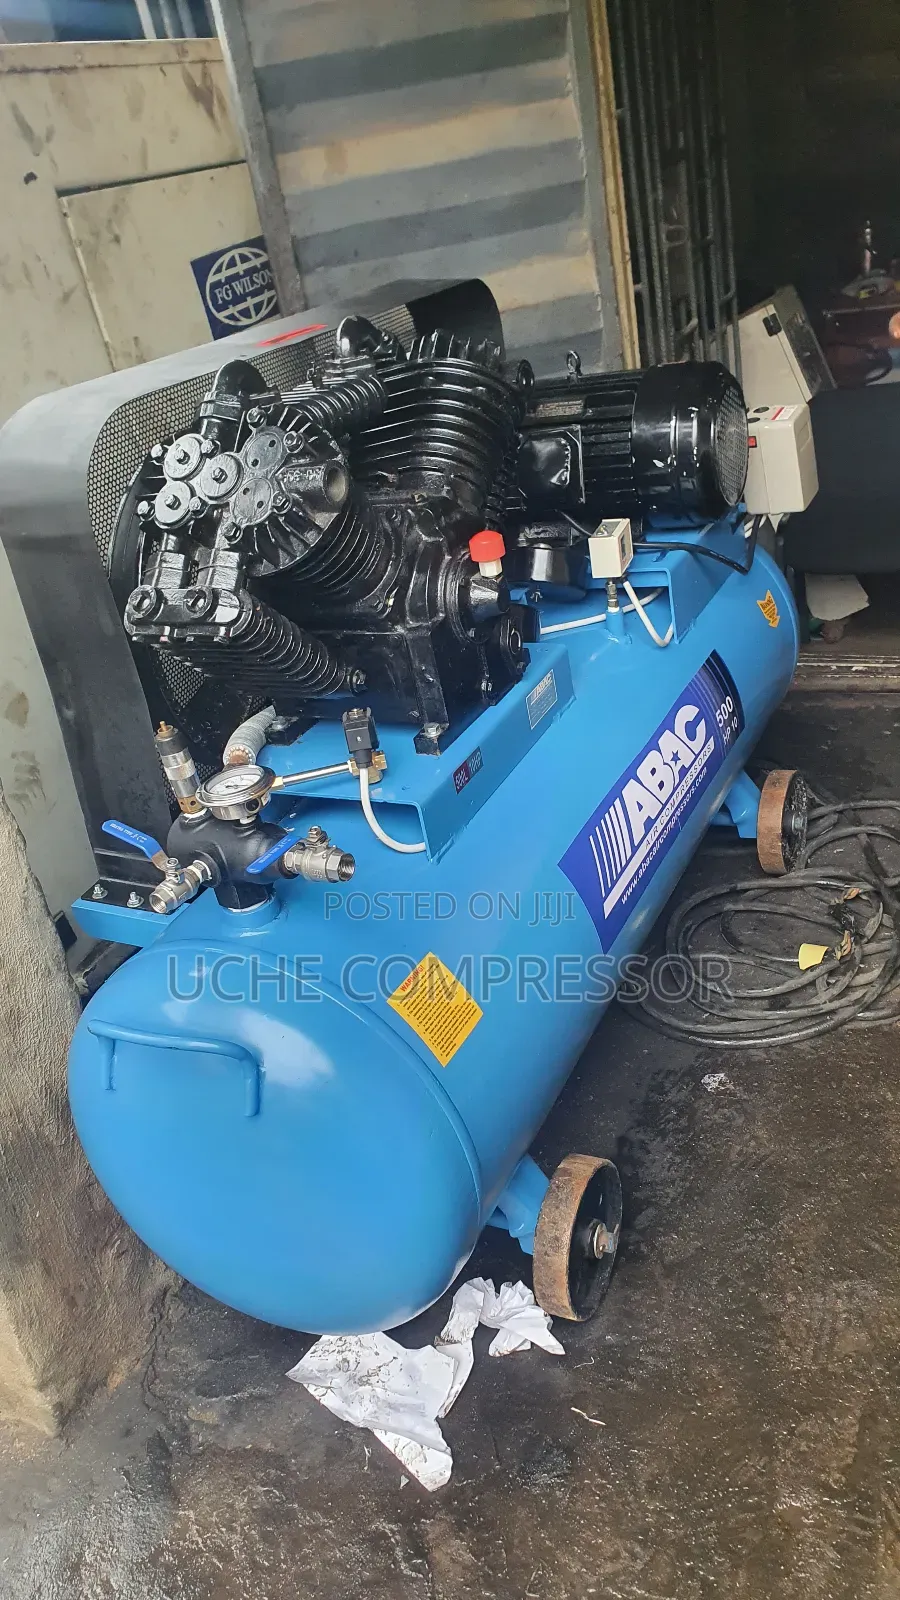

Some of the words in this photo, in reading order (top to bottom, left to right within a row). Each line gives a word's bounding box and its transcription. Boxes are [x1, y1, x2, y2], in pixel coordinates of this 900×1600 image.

[214, 284, 232, 305] FG
[715, 695, 733, 728] 500
[722, 726, 731, 746] HP
[731, 716, 738, 731] 10
[621, 704, 706, 847] ABAC
[645, 825, 660, 850] AIR
[659, 743, 712, 826] COMPRESSORS
[621, 766, 708, 905] www.abacaircompressors.com
[400, 964, 425, 992] WARNING!
